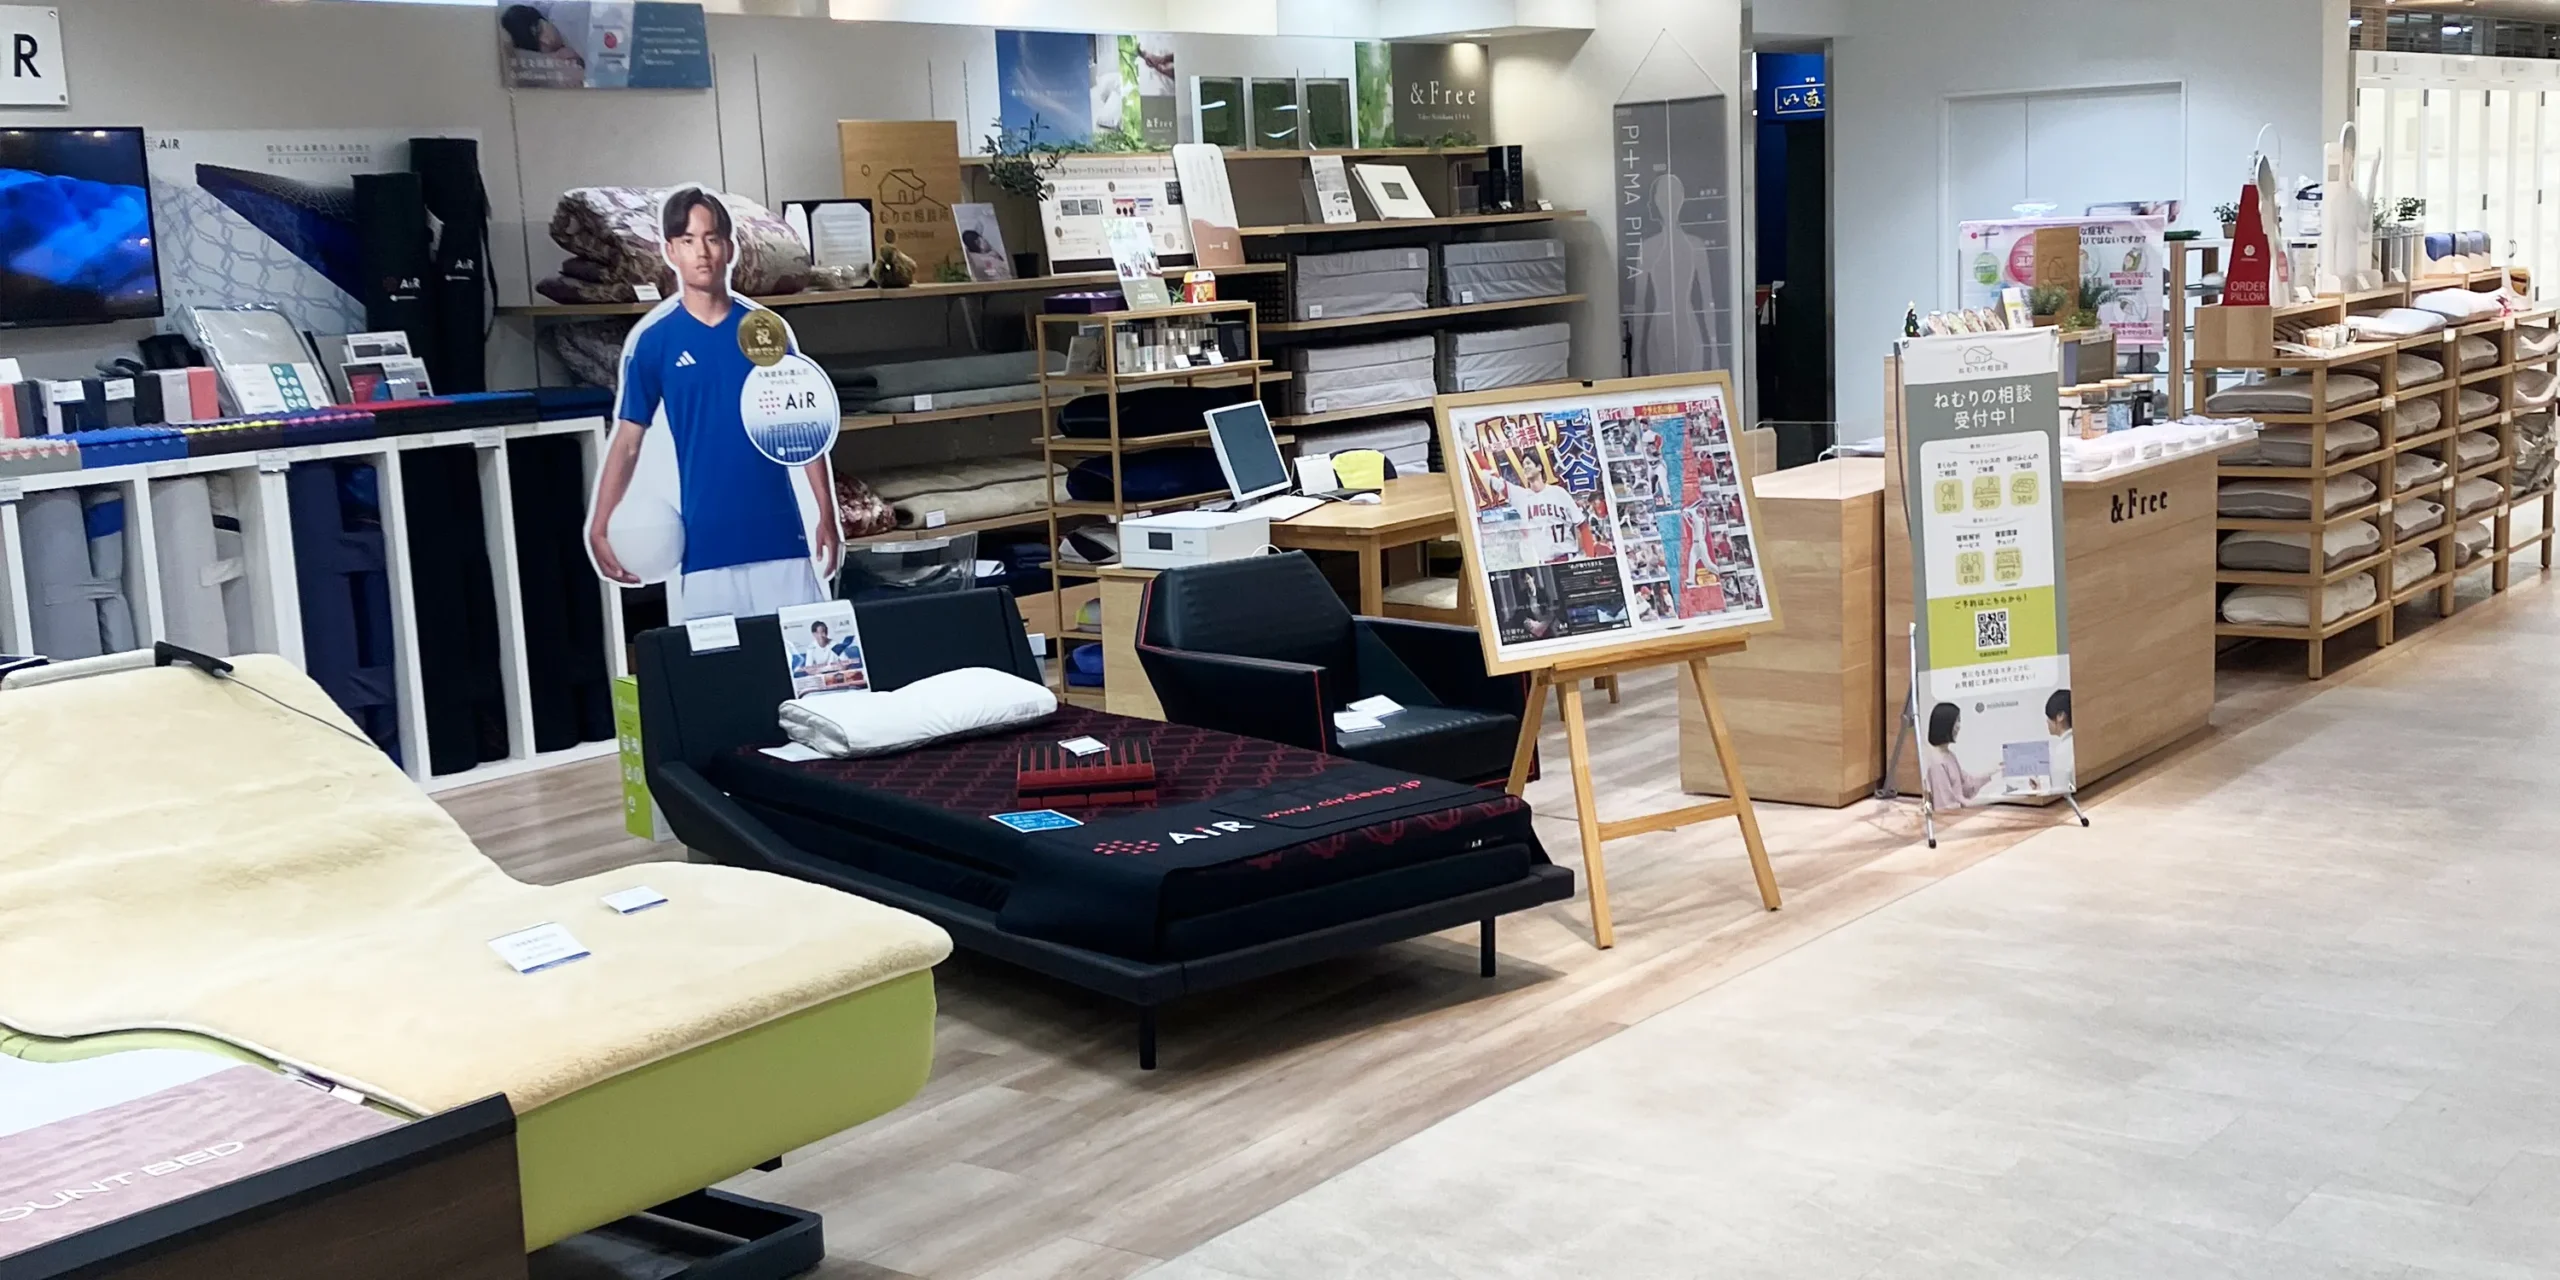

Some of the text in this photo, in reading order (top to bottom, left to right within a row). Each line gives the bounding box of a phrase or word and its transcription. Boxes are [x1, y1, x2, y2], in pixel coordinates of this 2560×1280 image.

[872, 208, 950, 225] むりの相談所
[1625, 216, 1643, 280] PITTA
[2078, 235, 2147, 246] りではないですか?
[2230, 281, 2267, 291] ORDER
[2230, 292, 2266, 302] PILLOW
[785, 391, 816, 410] AiR
[1934, 383, 2033, 409] ねむりの相談
[1558, 418, 1600, 494] 大谷
[1527, 503, 1566, 520] ANGELS
[2111, 487, 2168, 524] &Free
[1551, 524, 1565, 543] 17
[1168, 821, 1256, 845] AiR
[141, 1141, 244, 1177] BED
